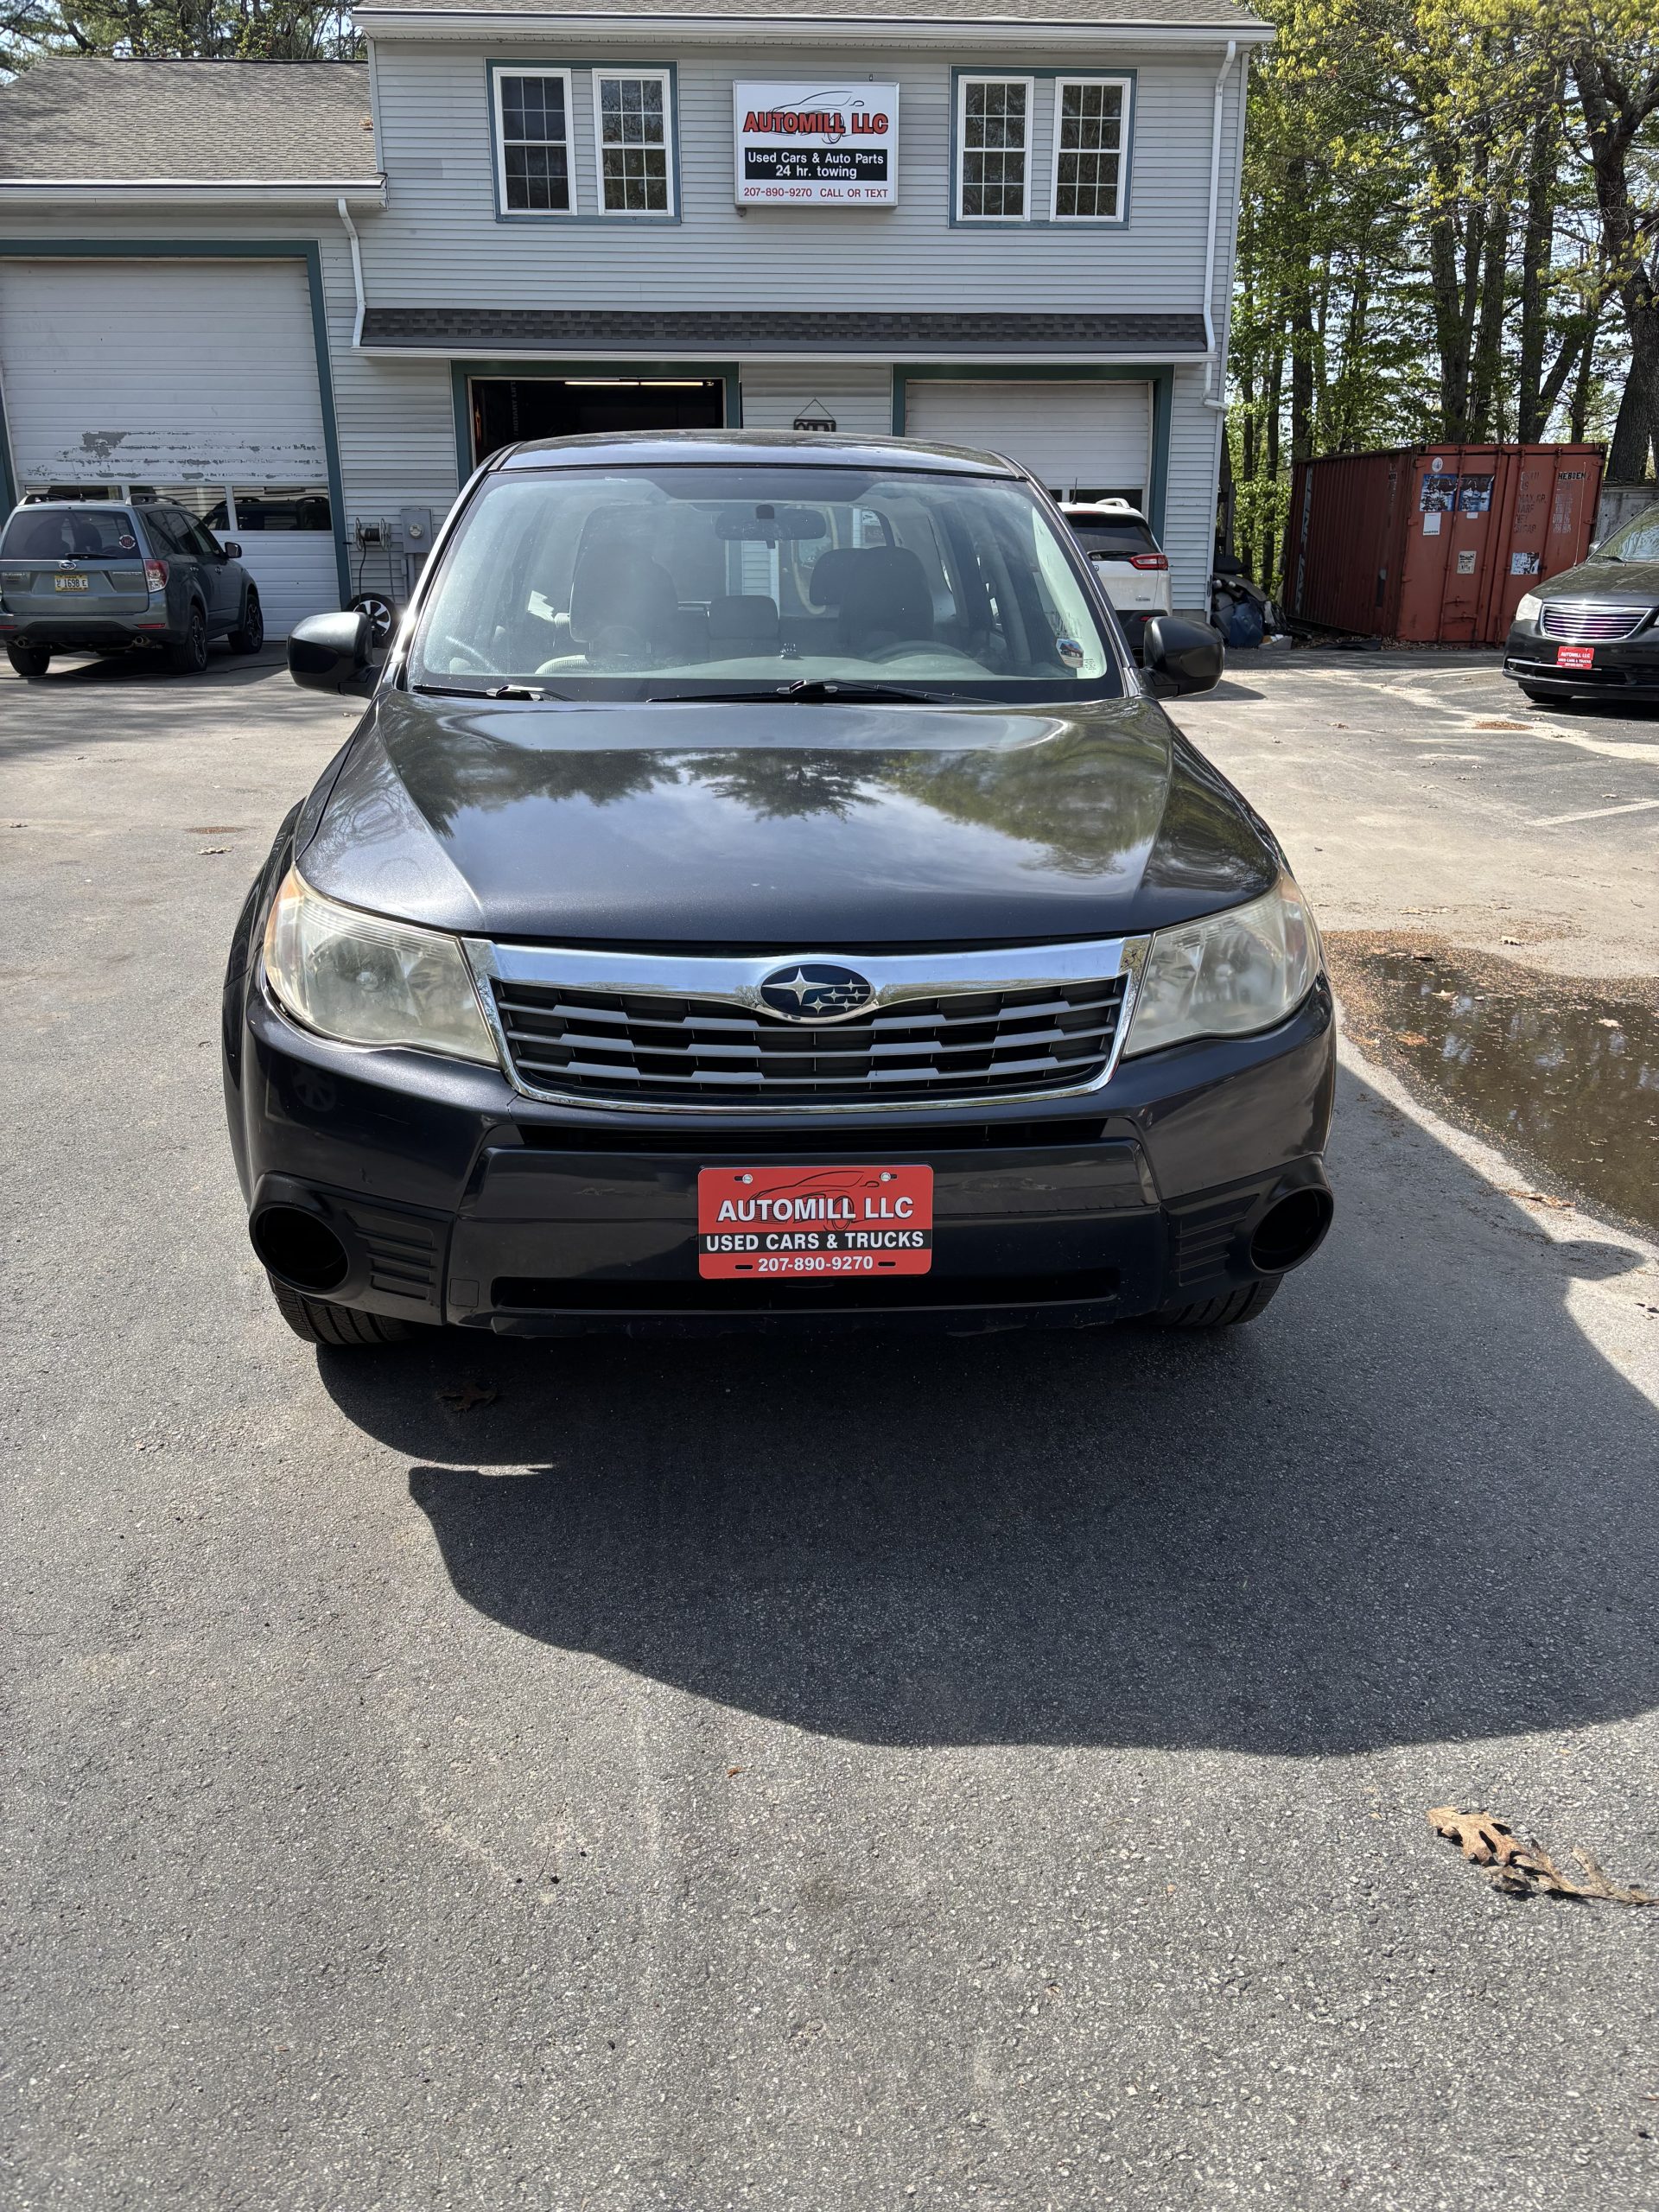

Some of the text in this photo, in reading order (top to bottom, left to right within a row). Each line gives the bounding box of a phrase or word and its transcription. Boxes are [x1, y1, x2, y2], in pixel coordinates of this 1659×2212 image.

[742, 111, 889, 135] AUTOMILL LLC
[747, 152, 884, 164] Used Cars & Auto Parts
[775, 165, 857, 179] 24 hr. towing
[744, 188, 888, 198] 207-890-9270 CALL OR TEXT
[64, 579, 80, 588] 1698
[716, 1197, 913, 1222] AUTOMILL LLC
[706, 1230, 925, 1251] USED CARS & TRUCKS
[758, 1255, 874, 1272] 207-890-9270
